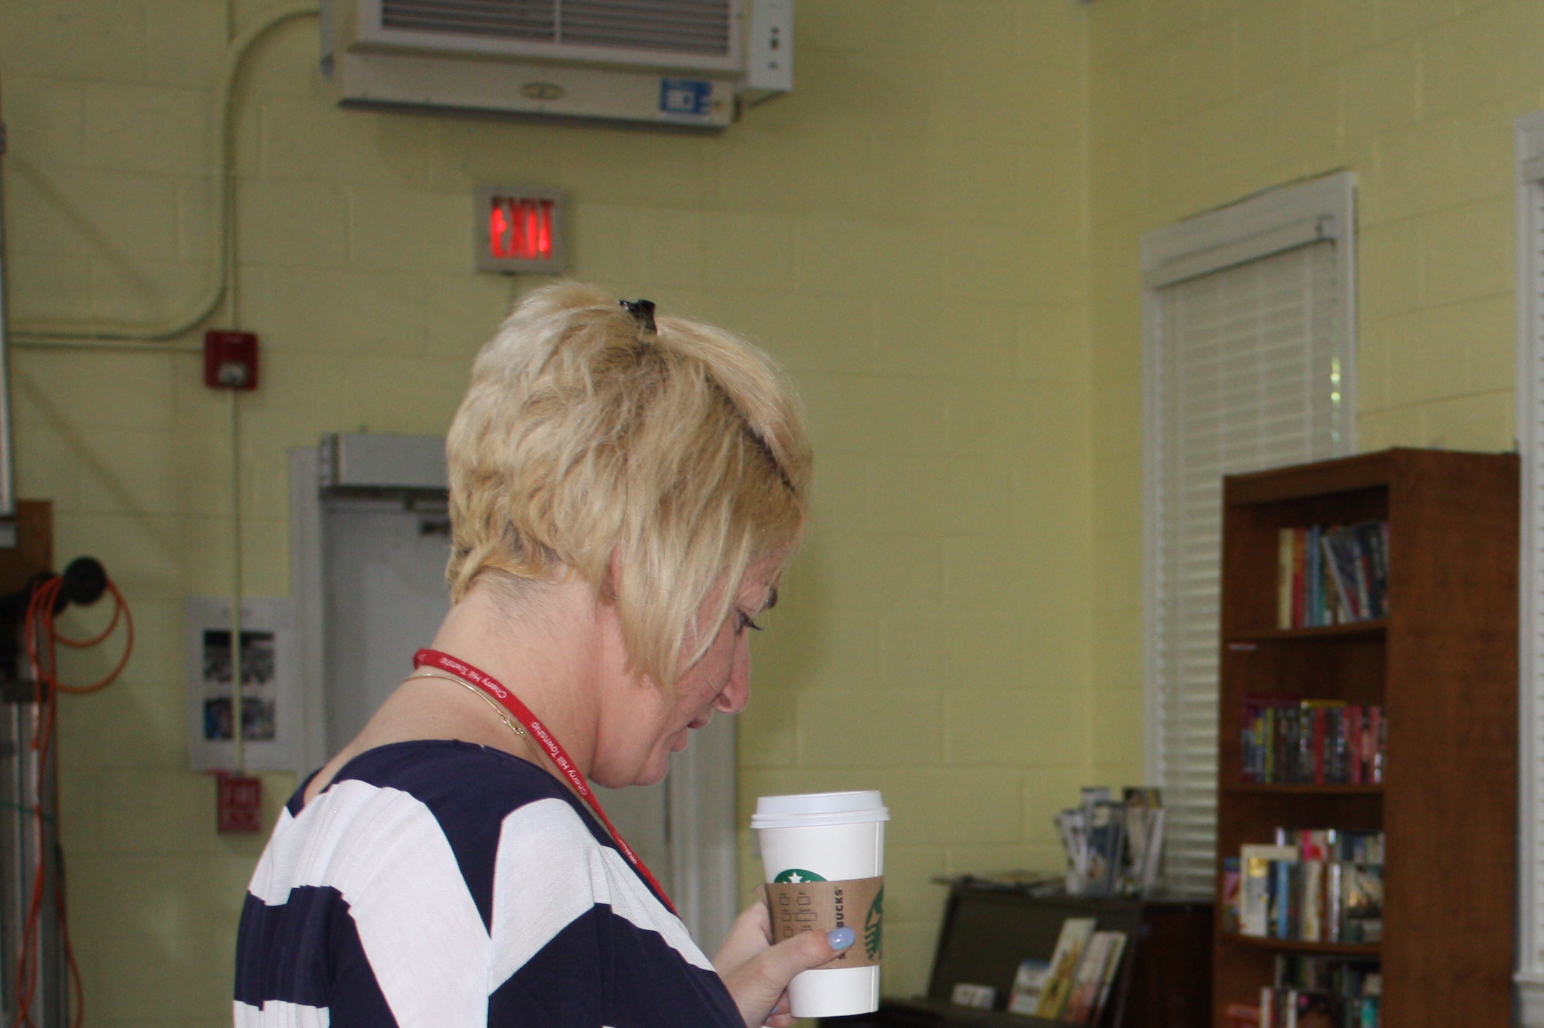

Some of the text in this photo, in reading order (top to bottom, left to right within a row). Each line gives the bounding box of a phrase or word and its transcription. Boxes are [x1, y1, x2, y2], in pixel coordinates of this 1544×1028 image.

[490, 197, 555, 260] EXIT
[468, 669, 482, 682] Hill
[482, 677, 508, 699] Cherry
[531, 721, 588, 796] Cherry Hill Township
[834, 887, 847, 961] SBUCKS
